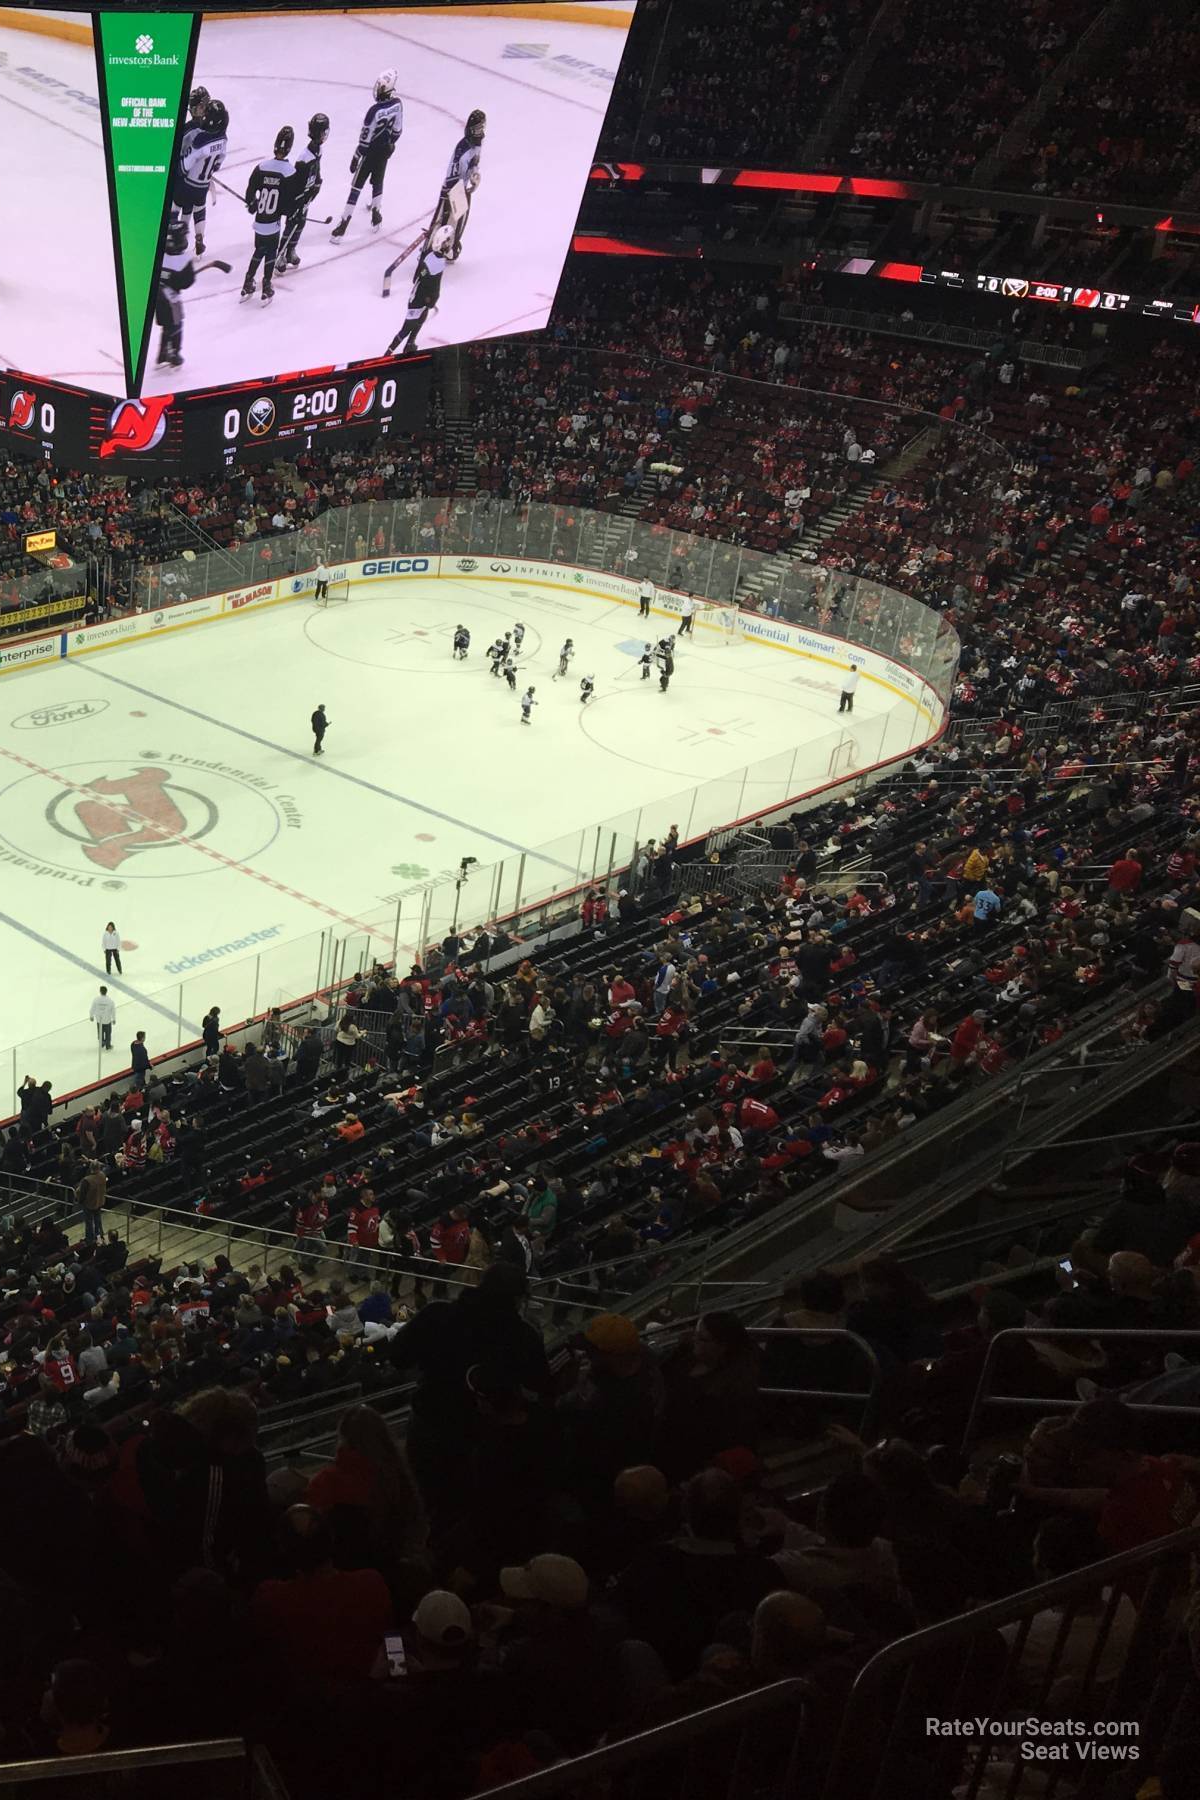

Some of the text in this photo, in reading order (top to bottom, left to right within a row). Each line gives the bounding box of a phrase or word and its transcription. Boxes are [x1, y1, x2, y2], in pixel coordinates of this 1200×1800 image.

[1036, 286, 1058, 298] 2:00
[292, 388, 338, 420] 2:00
[381, 379, 397, 409] 0
[40, 402, 56, 434] 0
[224, 408, 240, 440] 0
[306, 435, 312, 449] 1
[362, 559, 429, 576] GEICO
[516, 566, 566, 580] INFINITI
[738, 618, 790, 644] Prudential
[798, 634, 836, 654] Walmart
[30, 703, 95, 726] Ford
[166, 753, 304, 830] Prudential Center
[164, 926, 280, 974] ticketmaster
[548, 1076, 560, 1090] 13
[726, 1080, 736, 1090] 9
[60, 1364, 75, 1385] 9
